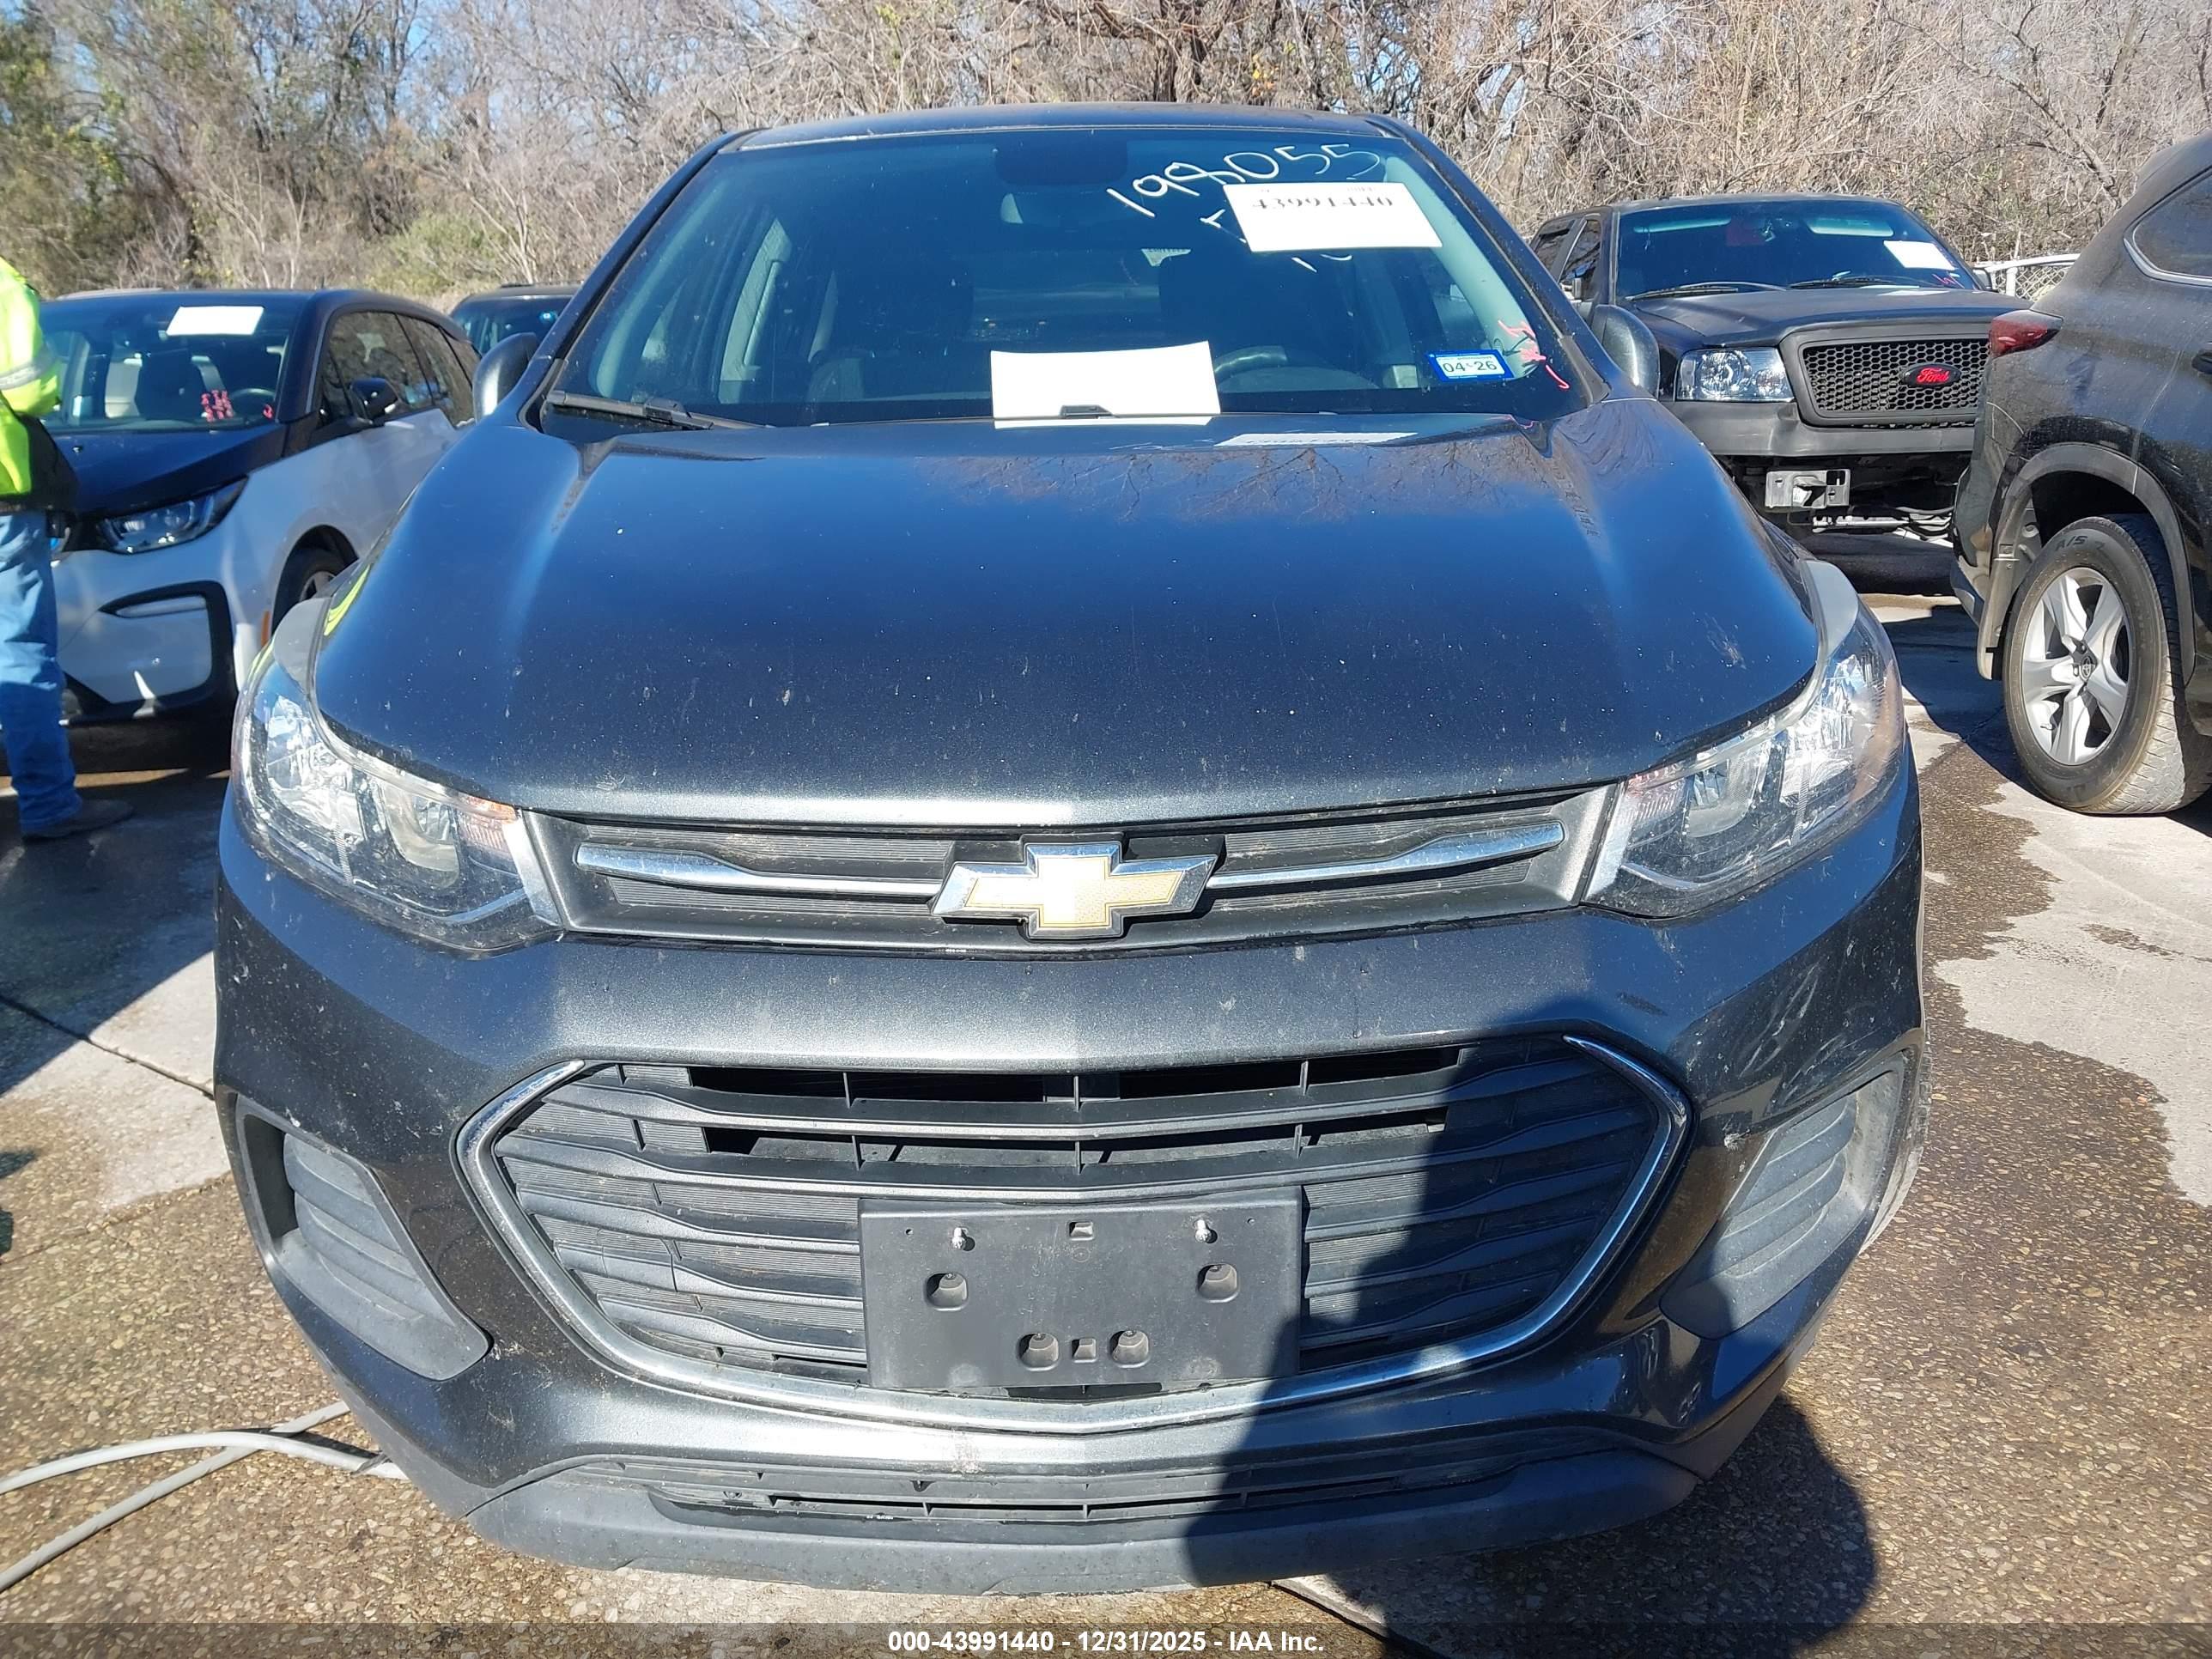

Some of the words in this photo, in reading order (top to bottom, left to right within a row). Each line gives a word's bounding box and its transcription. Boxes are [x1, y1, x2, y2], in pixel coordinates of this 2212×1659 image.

[1443, 362, 1466, 373] 04
[1474, 361, 1498, 371] 26
[1917, 367, 1950, 383] Ford
